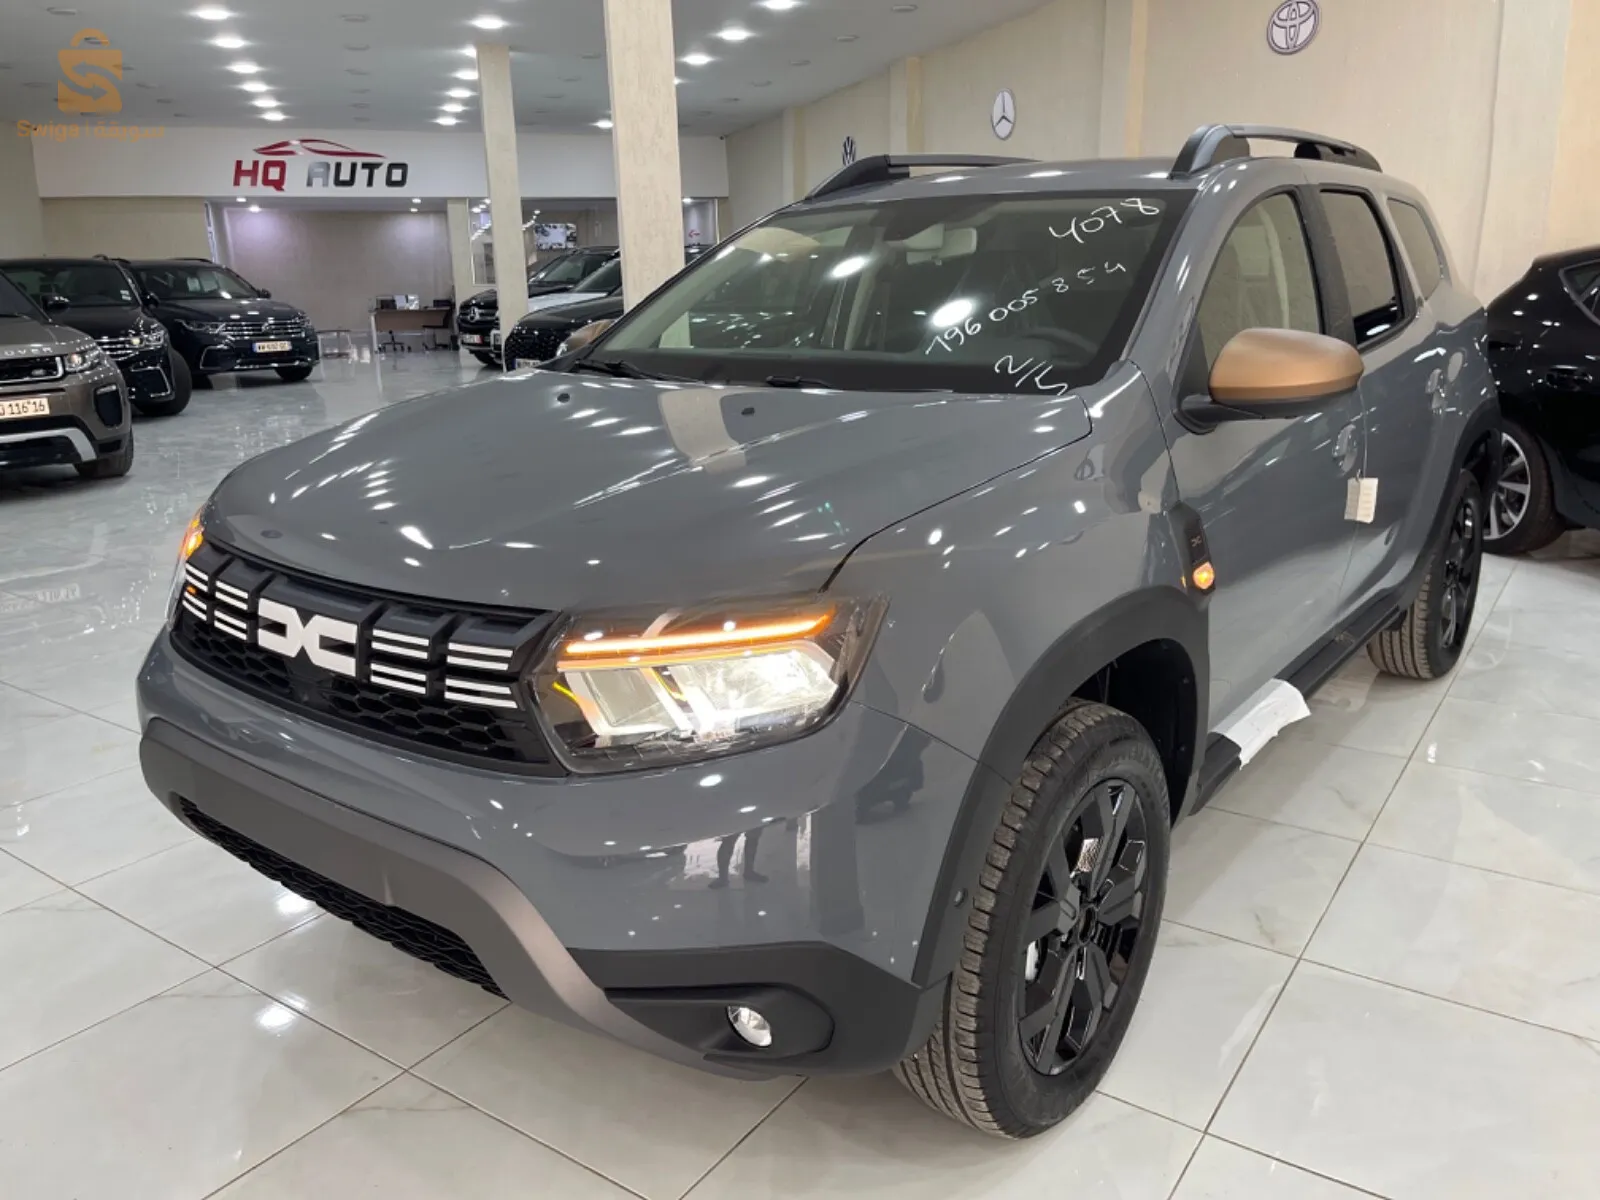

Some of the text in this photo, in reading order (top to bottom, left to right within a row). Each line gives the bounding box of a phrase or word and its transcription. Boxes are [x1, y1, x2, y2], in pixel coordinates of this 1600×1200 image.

[233, 160, 409, 191] HQ AUTO
[1049, 197, 1160, 243] 4078
